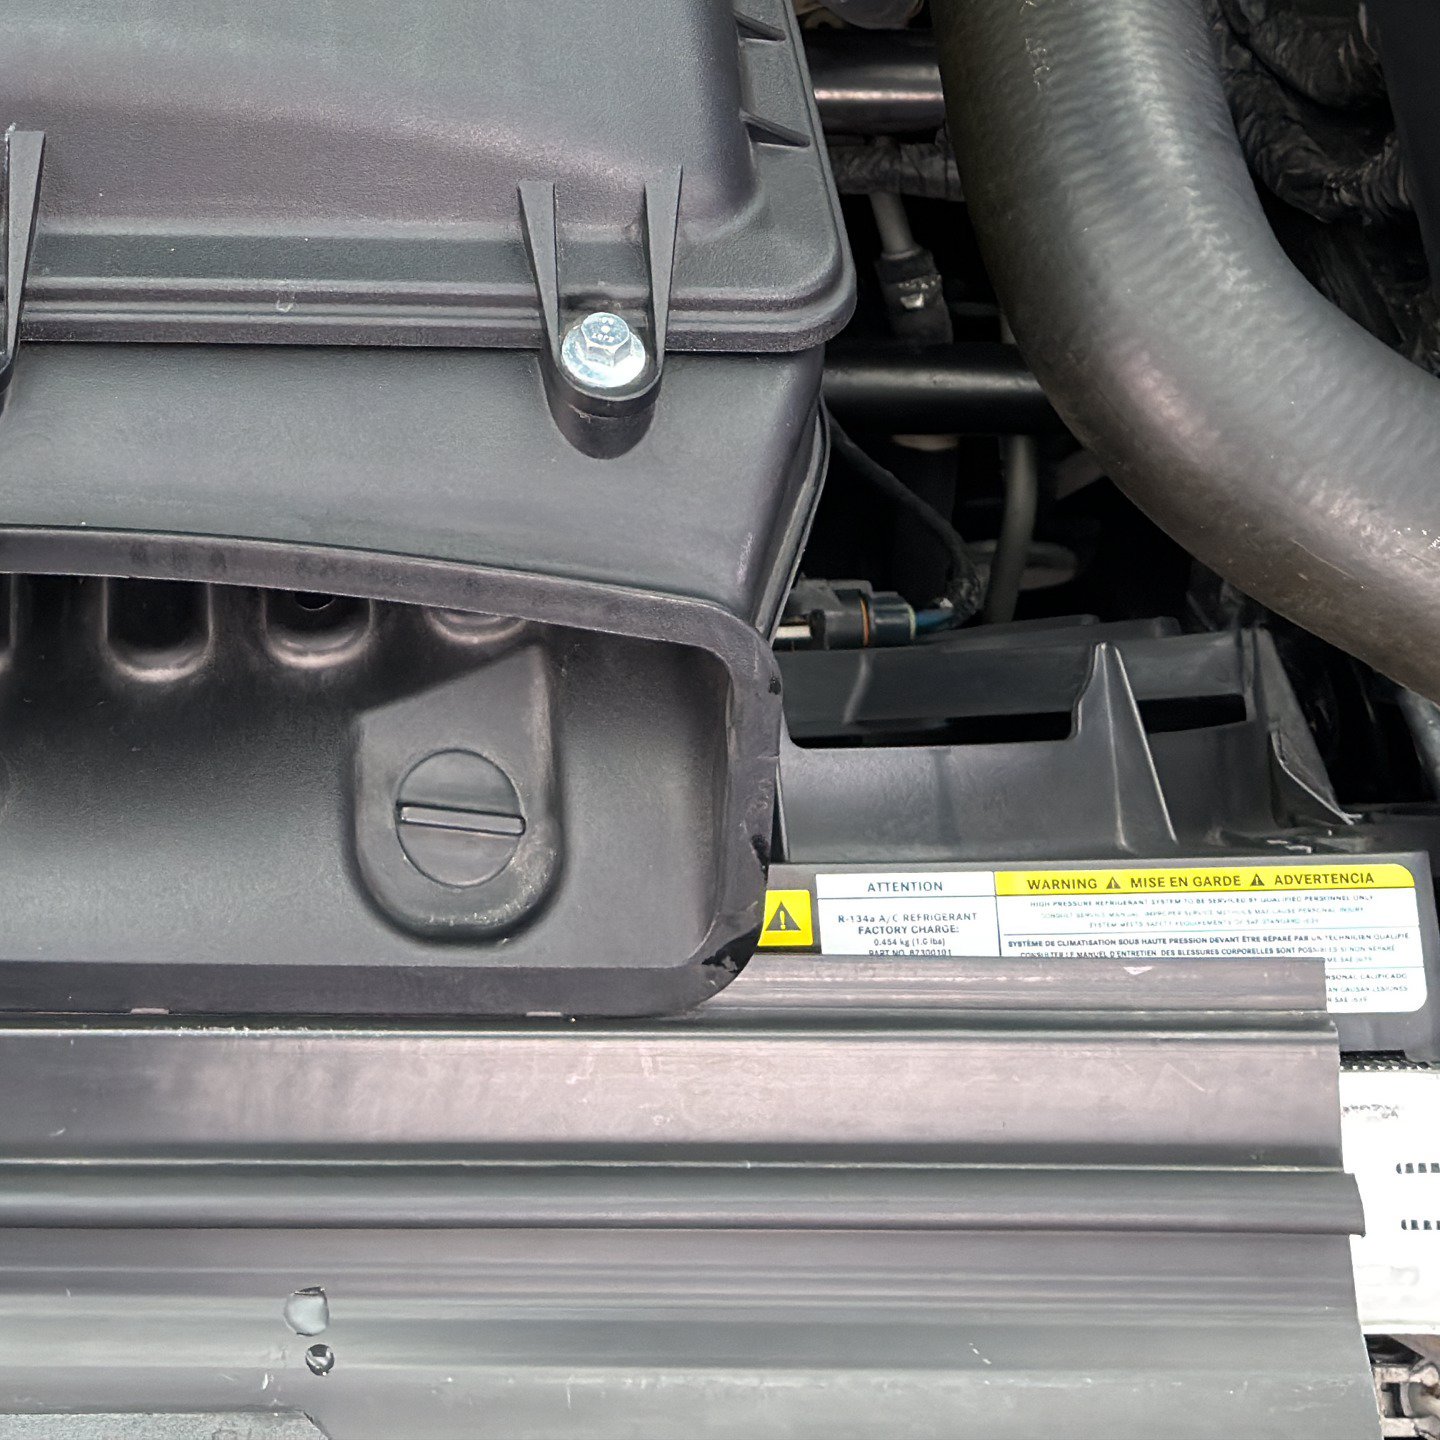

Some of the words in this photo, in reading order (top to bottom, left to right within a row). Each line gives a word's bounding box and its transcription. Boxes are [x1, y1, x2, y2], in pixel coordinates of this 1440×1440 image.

[1130, 877, 1165, 888] MISE
[1170, 876, 1188, 887] EN
[1193, 875, 1241, 887] GARDE
[1274, 872, 1375, 885] ADVERTENCIA
[867, 881, 943, 892] ATTENTION
[1028, 879, 1098, 890] WARNING
[838, 914, 875, 924] R-134a
[878, 914, 899, 923] A/C
[903, 912, 978, 922] REFRIGERANT
[858, 925, 907, 935] FACTORY
[911, 924, 960, 934] CHARGE:
[873, 938, 898, 946] 0.454
[899, 938, 910, 948] kg
[1008, 938, 1043, 948] SYSTÈME
[1057, 938, 1116, 947] CLIMATISATION
[1141, 937, 1167, 945] HAUTE
[1169, 937, 1207, 945] PRESSION
[1209, 936, 1239, 944] DEVANT
[1177, 948, 1219, 956] BLESSURES
[1221, 947, 1274, 955] CORPORELLES
[1276, 947, 1296, 955] SONT
